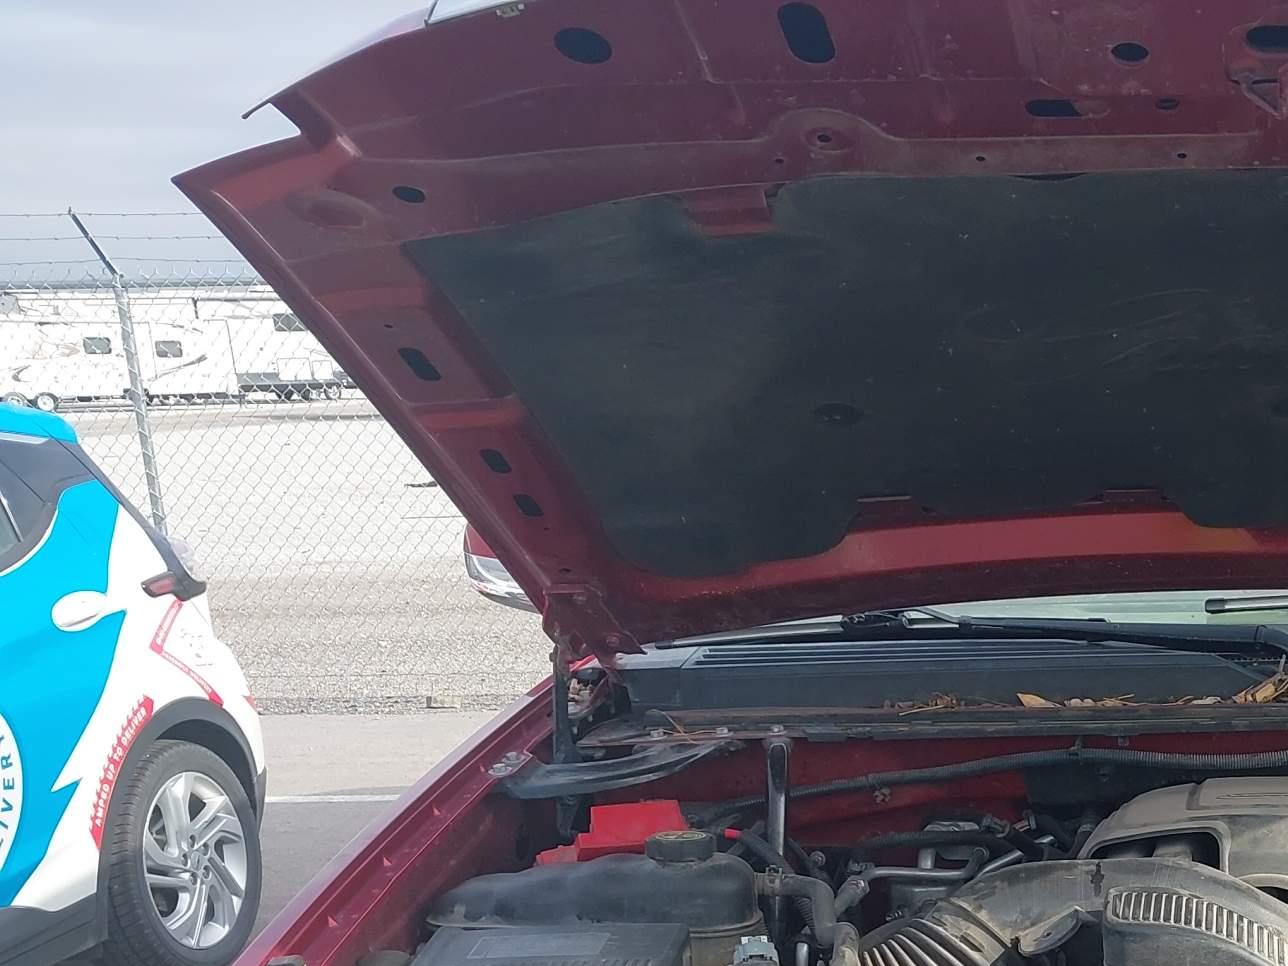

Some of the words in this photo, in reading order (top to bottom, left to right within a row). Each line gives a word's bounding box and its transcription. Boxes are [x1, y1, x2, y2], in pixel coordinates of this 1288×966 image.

[94, 782, 111, 828] AMPED
[105, 762, 117, 780] UP
[112, 747, 123, 762] TO
[120, 705, 148, 744] DELIVER
